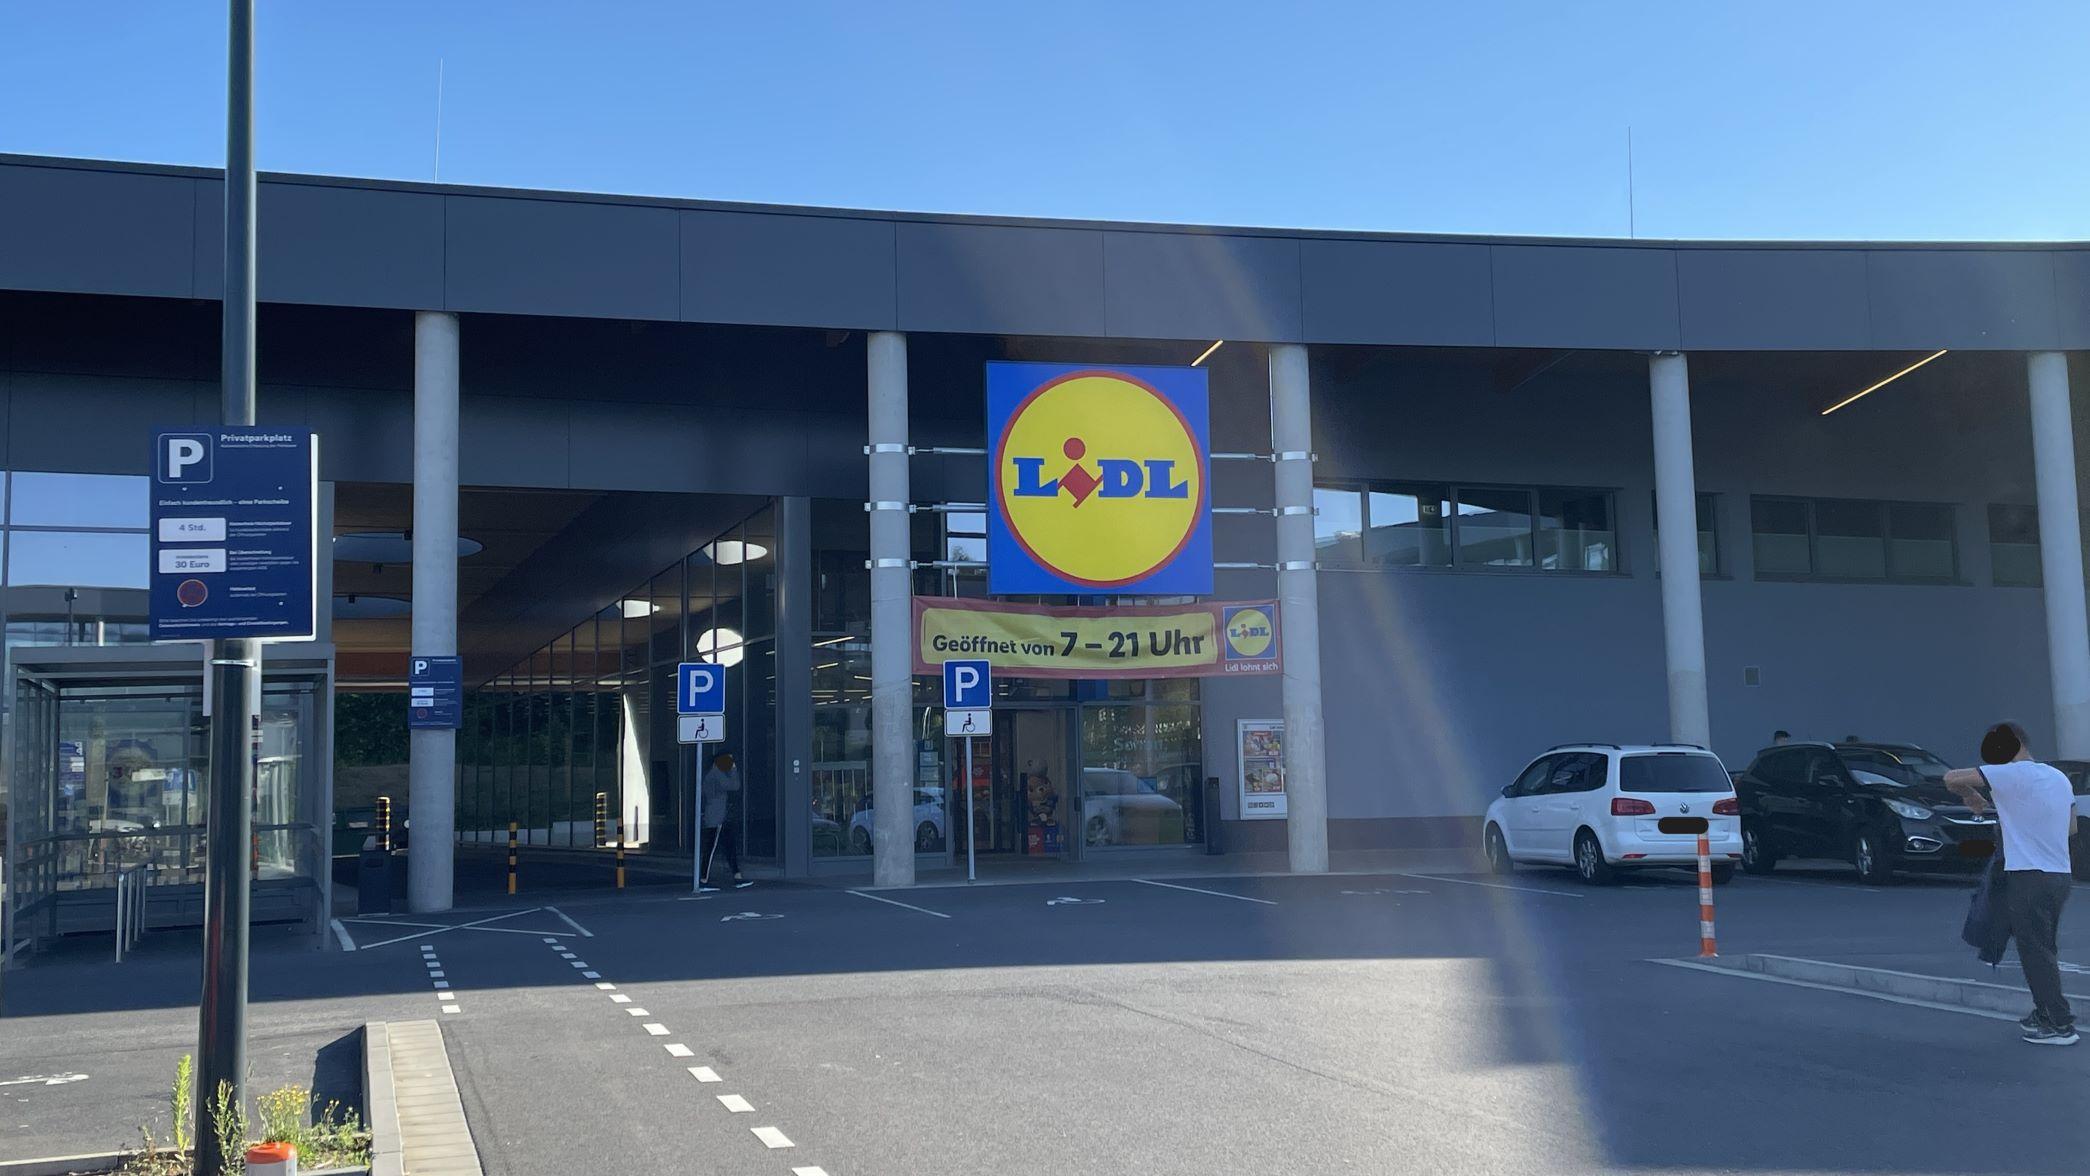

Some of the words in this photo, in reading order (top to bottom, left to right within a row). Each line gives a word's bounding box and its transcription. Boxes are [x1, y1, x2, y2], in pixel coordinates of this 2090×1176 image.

[220, 434, 292, 443] Privatparkplatz
[169, 439, 204, 478] P
[190, 560, 210, 568] Euro
[932, 634, 1016, 654] Geöffnet
[1021, 643, 1055, 656] von
[1060, 631, 1078, 657] 7
[1109, 631, 1139, 658] 21
[1150, 629, 1205, 657] Uhr
[415, 661, 427, 674] P
[1225, 664, 1238, 672] Lidl
[1241, 664, 1260, 672] lohnt
[1263, 662, 1278, 671] sich
[689, 670, 713, 706] P
[955, 666, 979, 702] P
